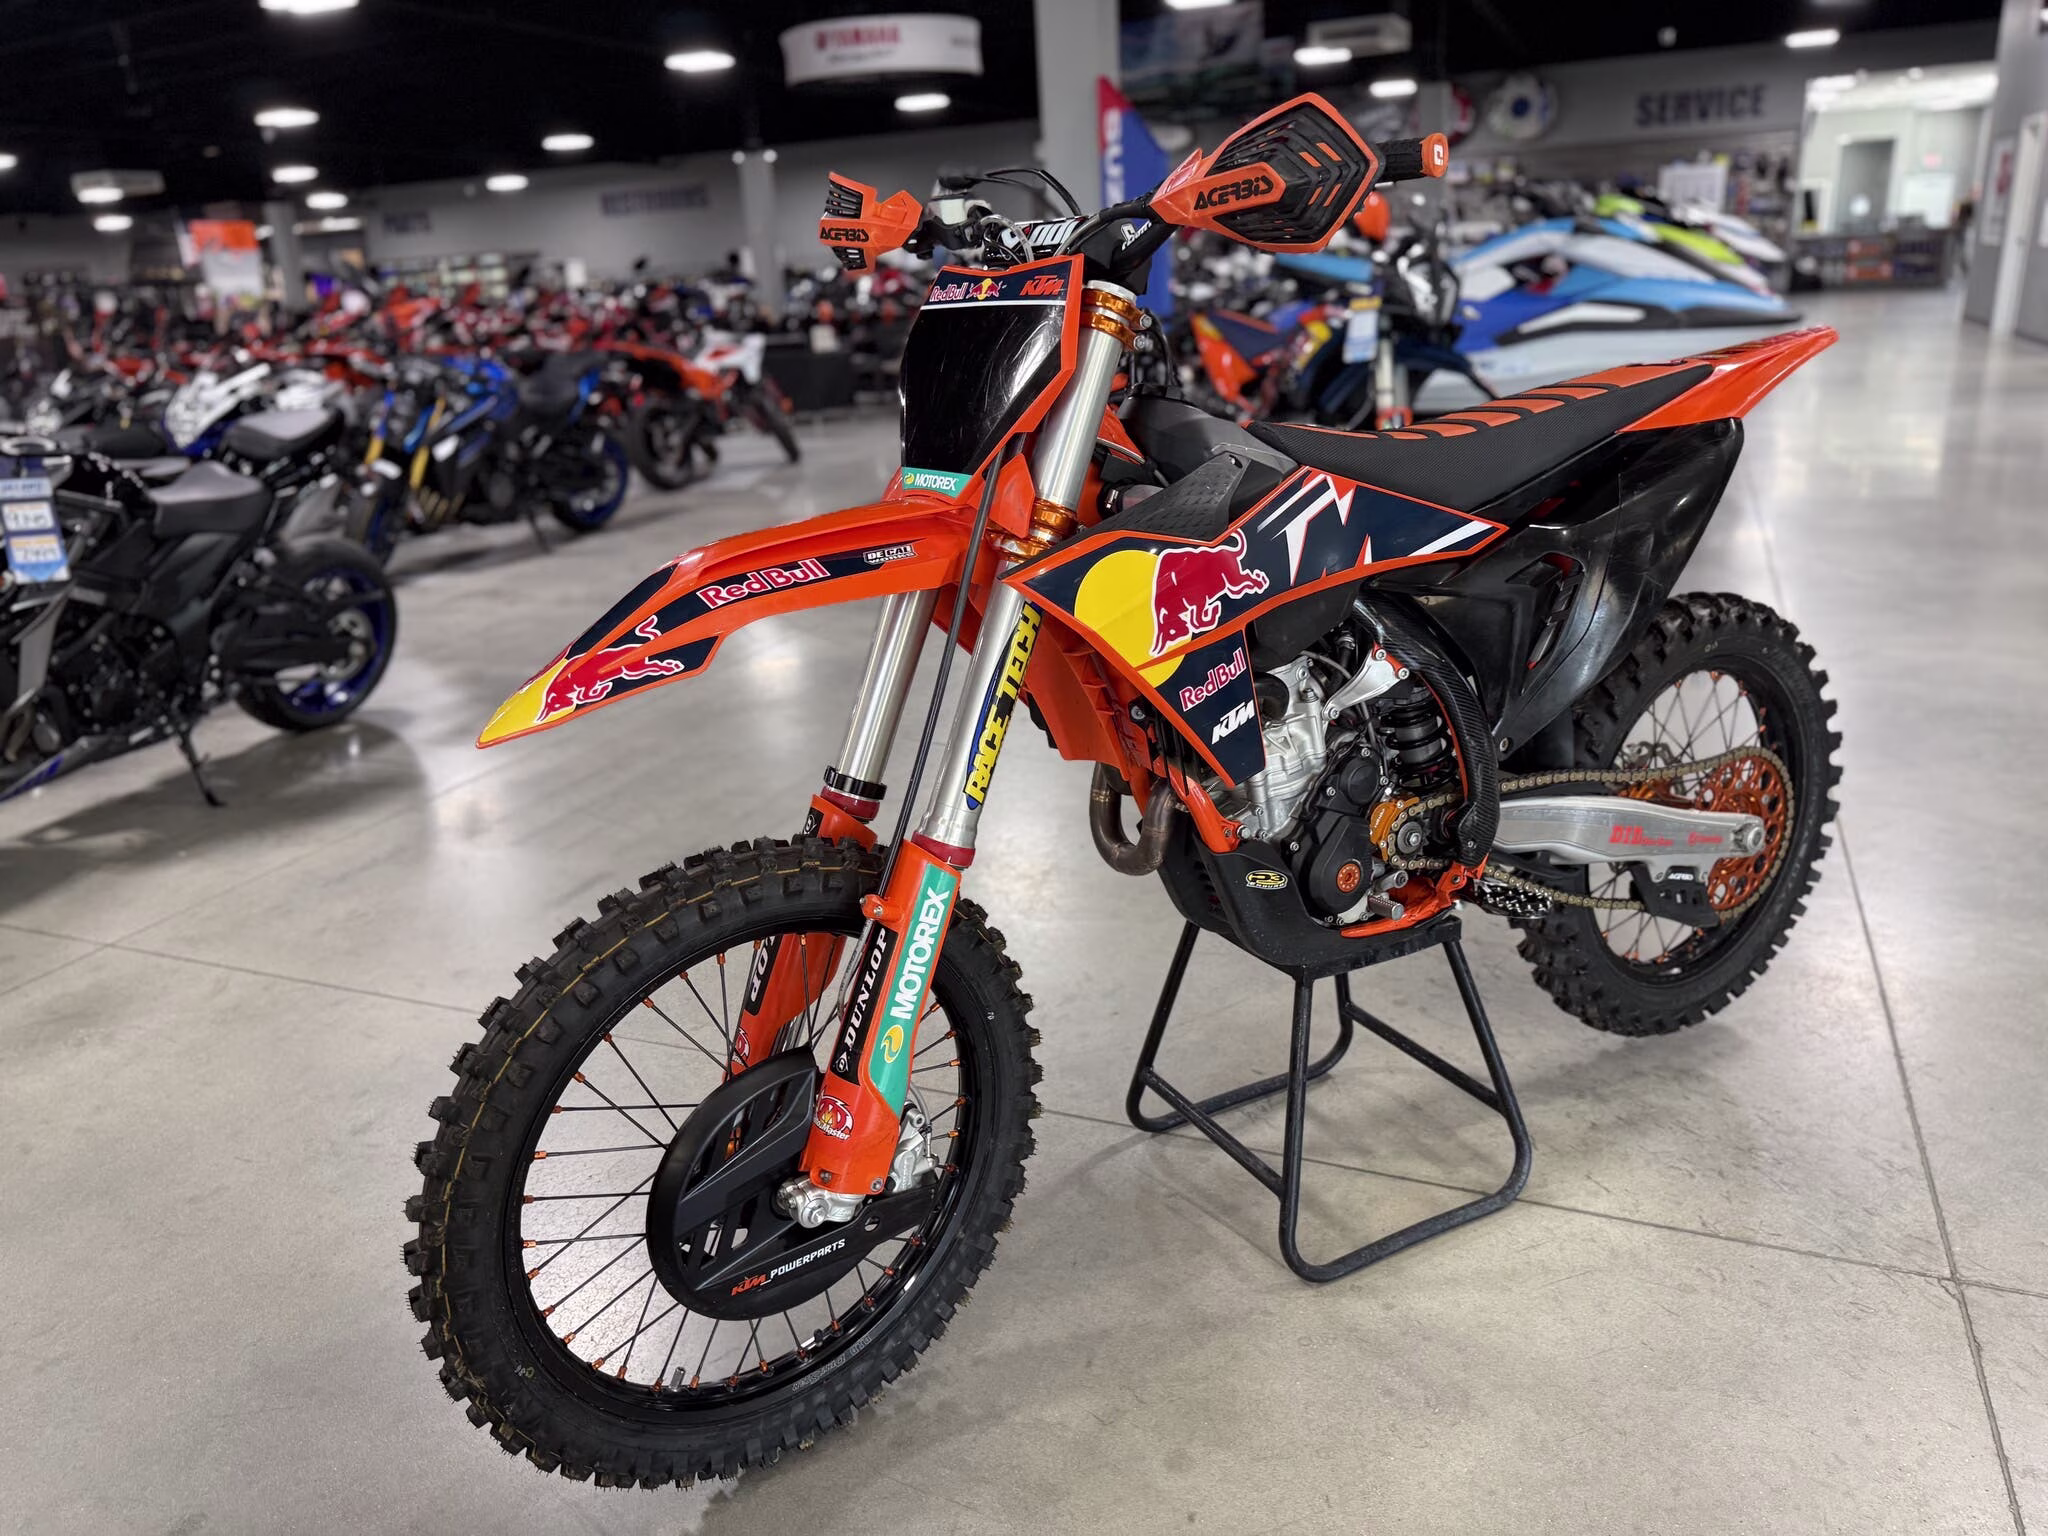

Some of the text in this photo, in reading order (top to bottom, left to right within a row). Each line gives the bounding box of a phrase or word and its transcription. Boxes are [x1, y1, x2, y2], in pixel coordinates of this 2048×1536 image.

[1637, 83, 1767, 127] SERVICE
[1194, 175, 1274, 211] ACERBIS
[1020, 275, 1065, 296] KTM
[914, 473, 956, 491] MOTOREX
[963, 601, 1042, 805] RACE TECH
[1212, 700, 1255, 745] KTM
[890, 886, 950, 1020] MOTOREX
[843, 928, 887, 1050] DUNLOP
[731, 1239, 846, 1296] KTM POWERPARTS
